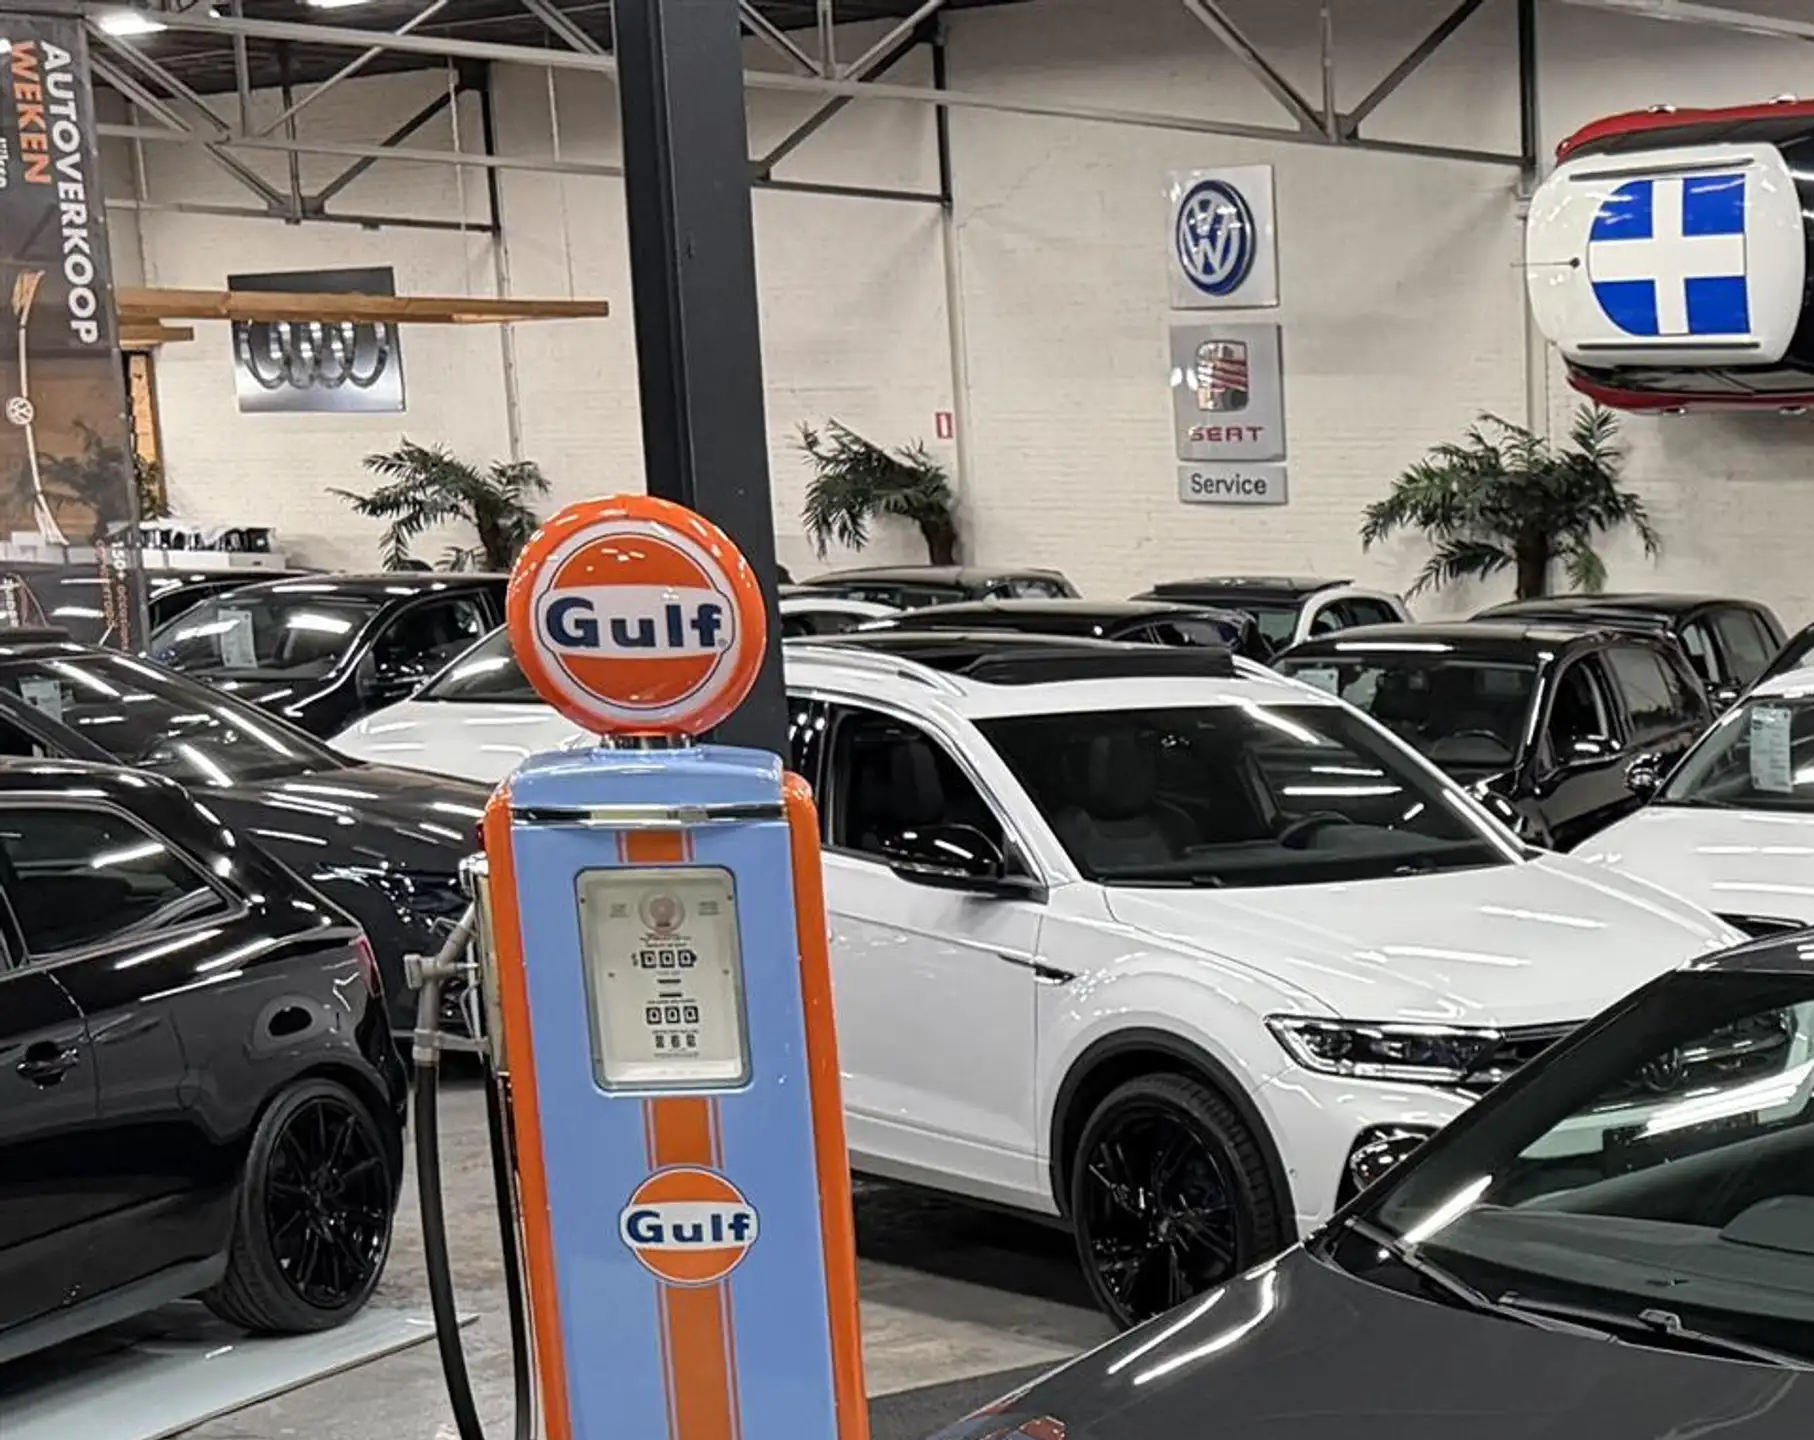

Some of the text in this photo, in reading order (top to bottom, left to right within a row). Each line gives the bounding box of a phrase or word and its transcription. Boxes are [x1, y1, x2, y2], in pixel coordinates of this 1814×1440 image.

[11, 39, 52, 185] WEKEN
[40, 40, 98, 344] AUTOVERKOOP
[1190, 425, 1265, 443] SEAT
[1190, 473, 1267, 495] Service
[545, 596, 722, 648] Gulf
[626, 1209, 750, 1243] Gulf
